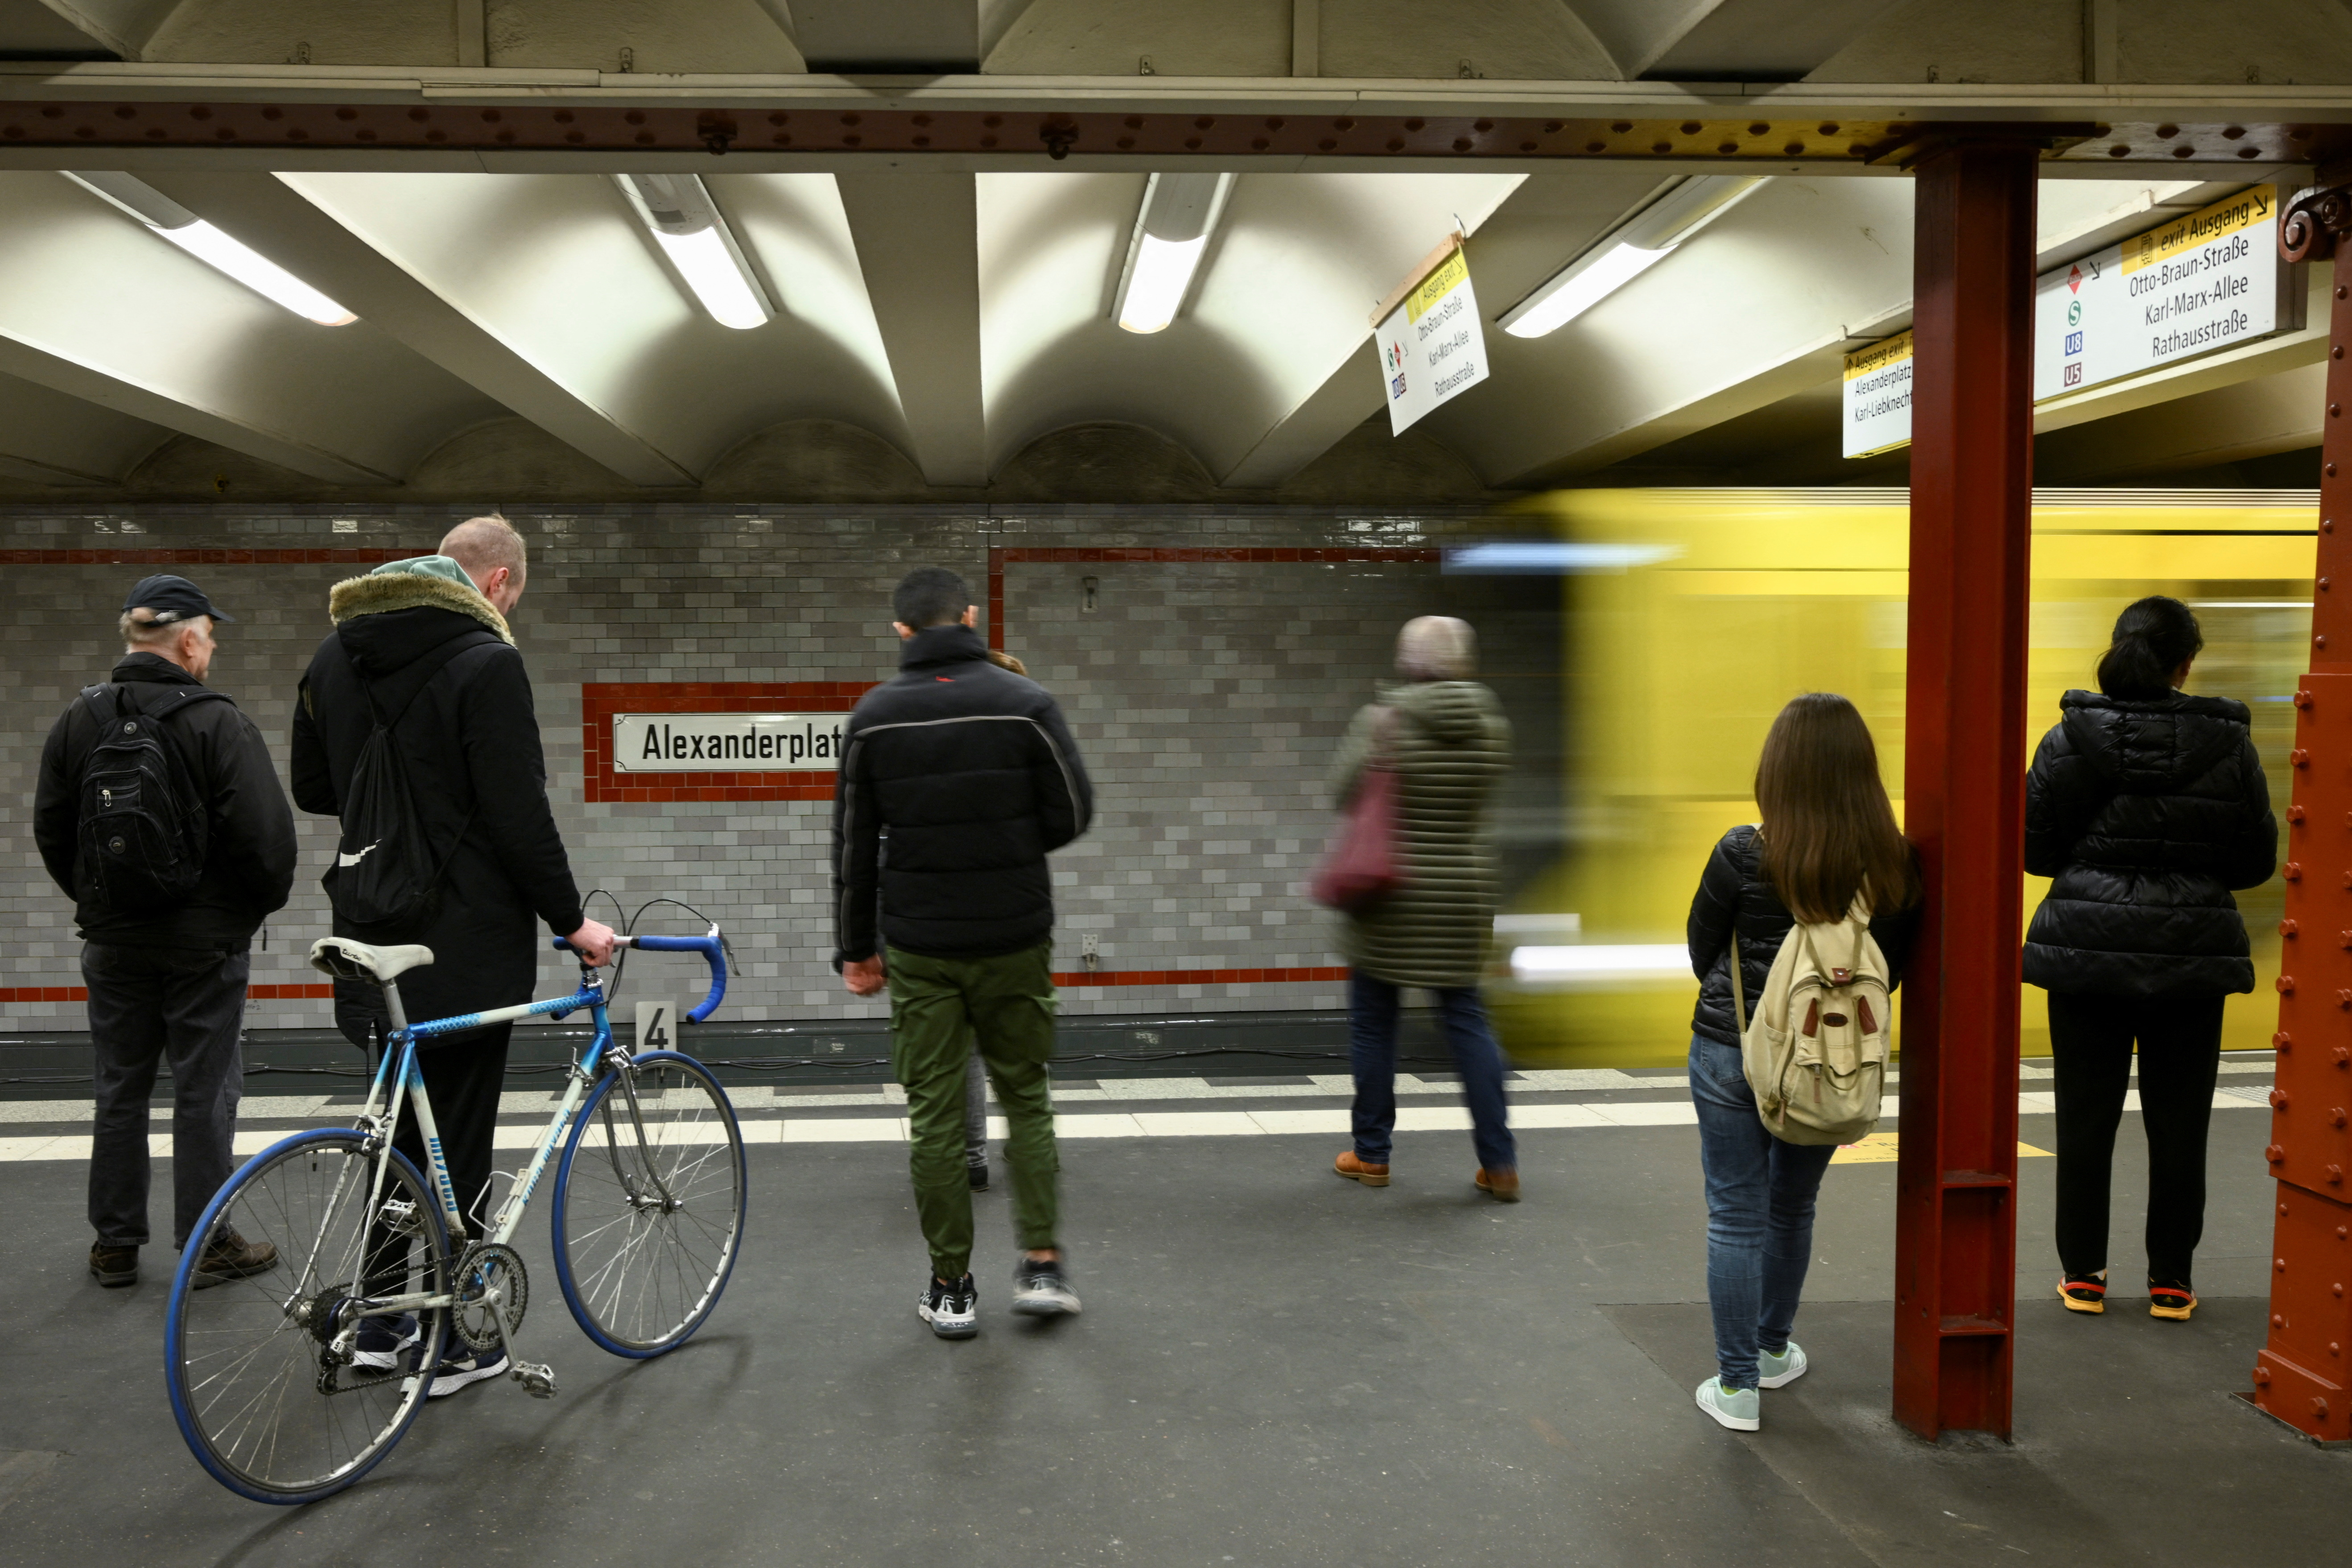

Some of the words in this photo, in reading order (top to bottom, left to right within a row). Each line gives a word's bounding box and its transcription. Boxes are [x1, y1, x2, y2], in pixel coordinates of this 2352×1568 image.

[2161, 223, 2185, 251] exit
[2189, 202, 2249, 240] Ausgang
[1422, 274, 1445, 302] Ausgang
[1444, 261, 1455, 282] exit
[2130, 235, 2249, 297] Otto-Braun-Straße
[1418, 296, 1463, 341] Otto-Braun-Straße
[2069, 301, 2080, 325] S
[2146, 275, 2248, 326] Karl-Marx-Allee
[1428, 330, 1469, 367] Karl-Marx-Allee
[2067, 333, 2081, 353] U8
[2153, 309, 2248, 357] Rathausstraße
[1855, 348, 1886, 371] Ausgang
[1889, 338, 1904, 358] exit
[1435, 362, 1474, 397] Rathausstraße
[1855, 365, 1911, 397] Alexanderplatz
[2065, 364, 2080, 384] U5
[643, 723, 845, 763] Alexanderplat
[342, 948, 362, 961] turbo
[644, 1008, 668, 1050] 4
